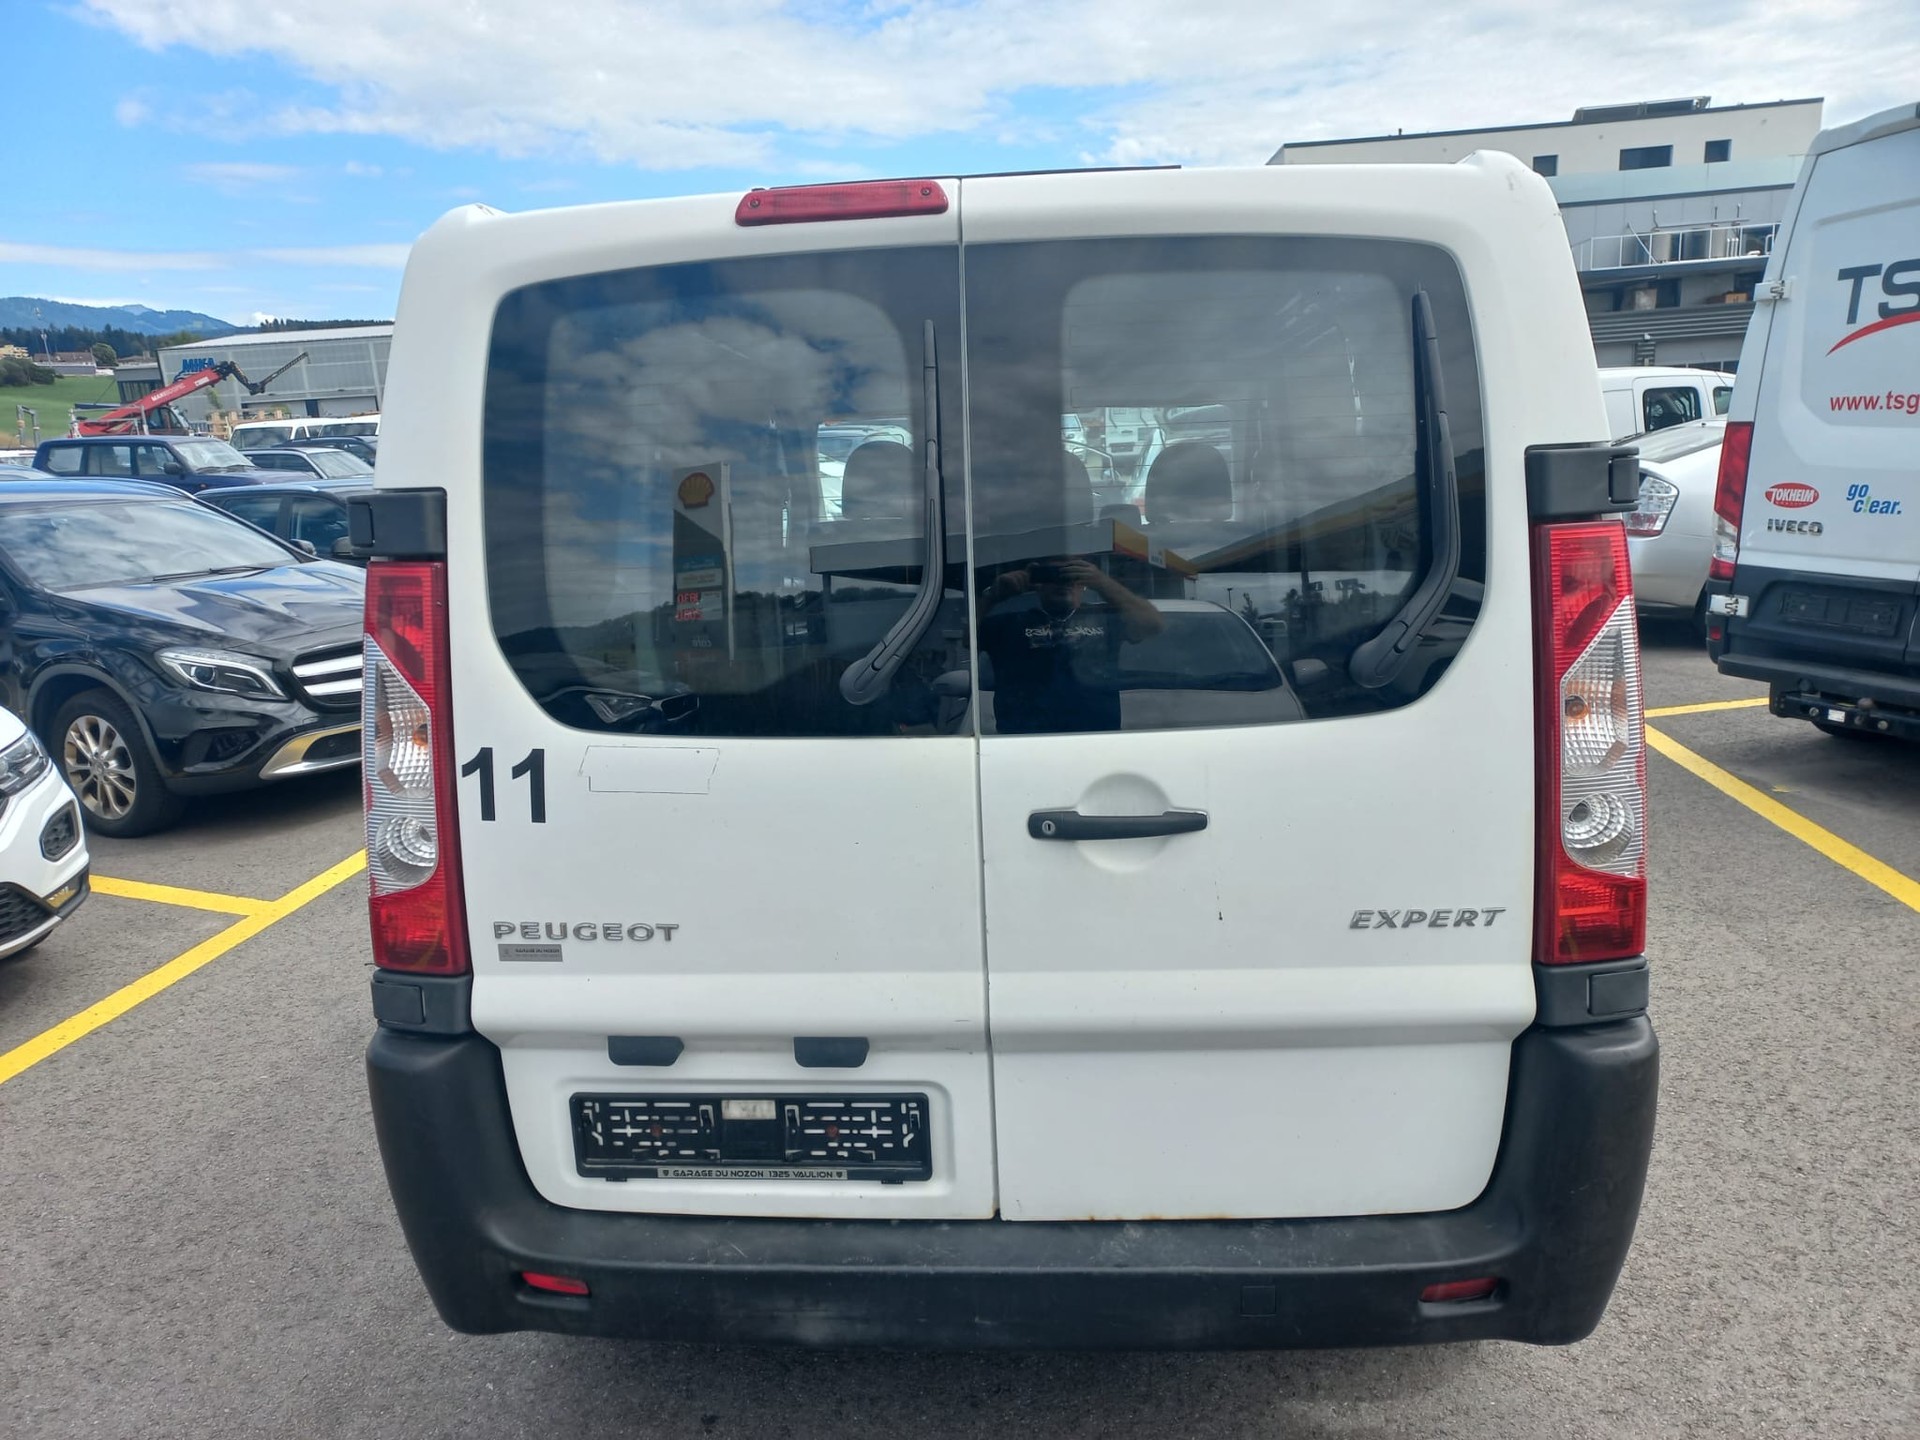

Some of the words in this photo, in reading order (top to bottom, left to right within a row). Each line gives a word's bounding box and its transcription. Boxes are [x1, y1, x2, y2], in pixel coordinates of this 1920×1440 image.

[1768, 488, 1815, 504] TOKHEIM
[1846, 484, 1869, 501] go
[1767, 518, 1823, 536] IVECO
[461, 746, 546, 823] 11
[1349, 907, 1507, 930] EXPERT
[493, 921, 679, 941] PEUGEOT
[672, 1169, 713, 1178] GARAGE
[715, 1169, 729, 1178] DU
[730, 1170, 764, 1178] NOZON
[769, 1170, 790, 1178] 1325
[792, 1170, 833, 1179] VAULION
